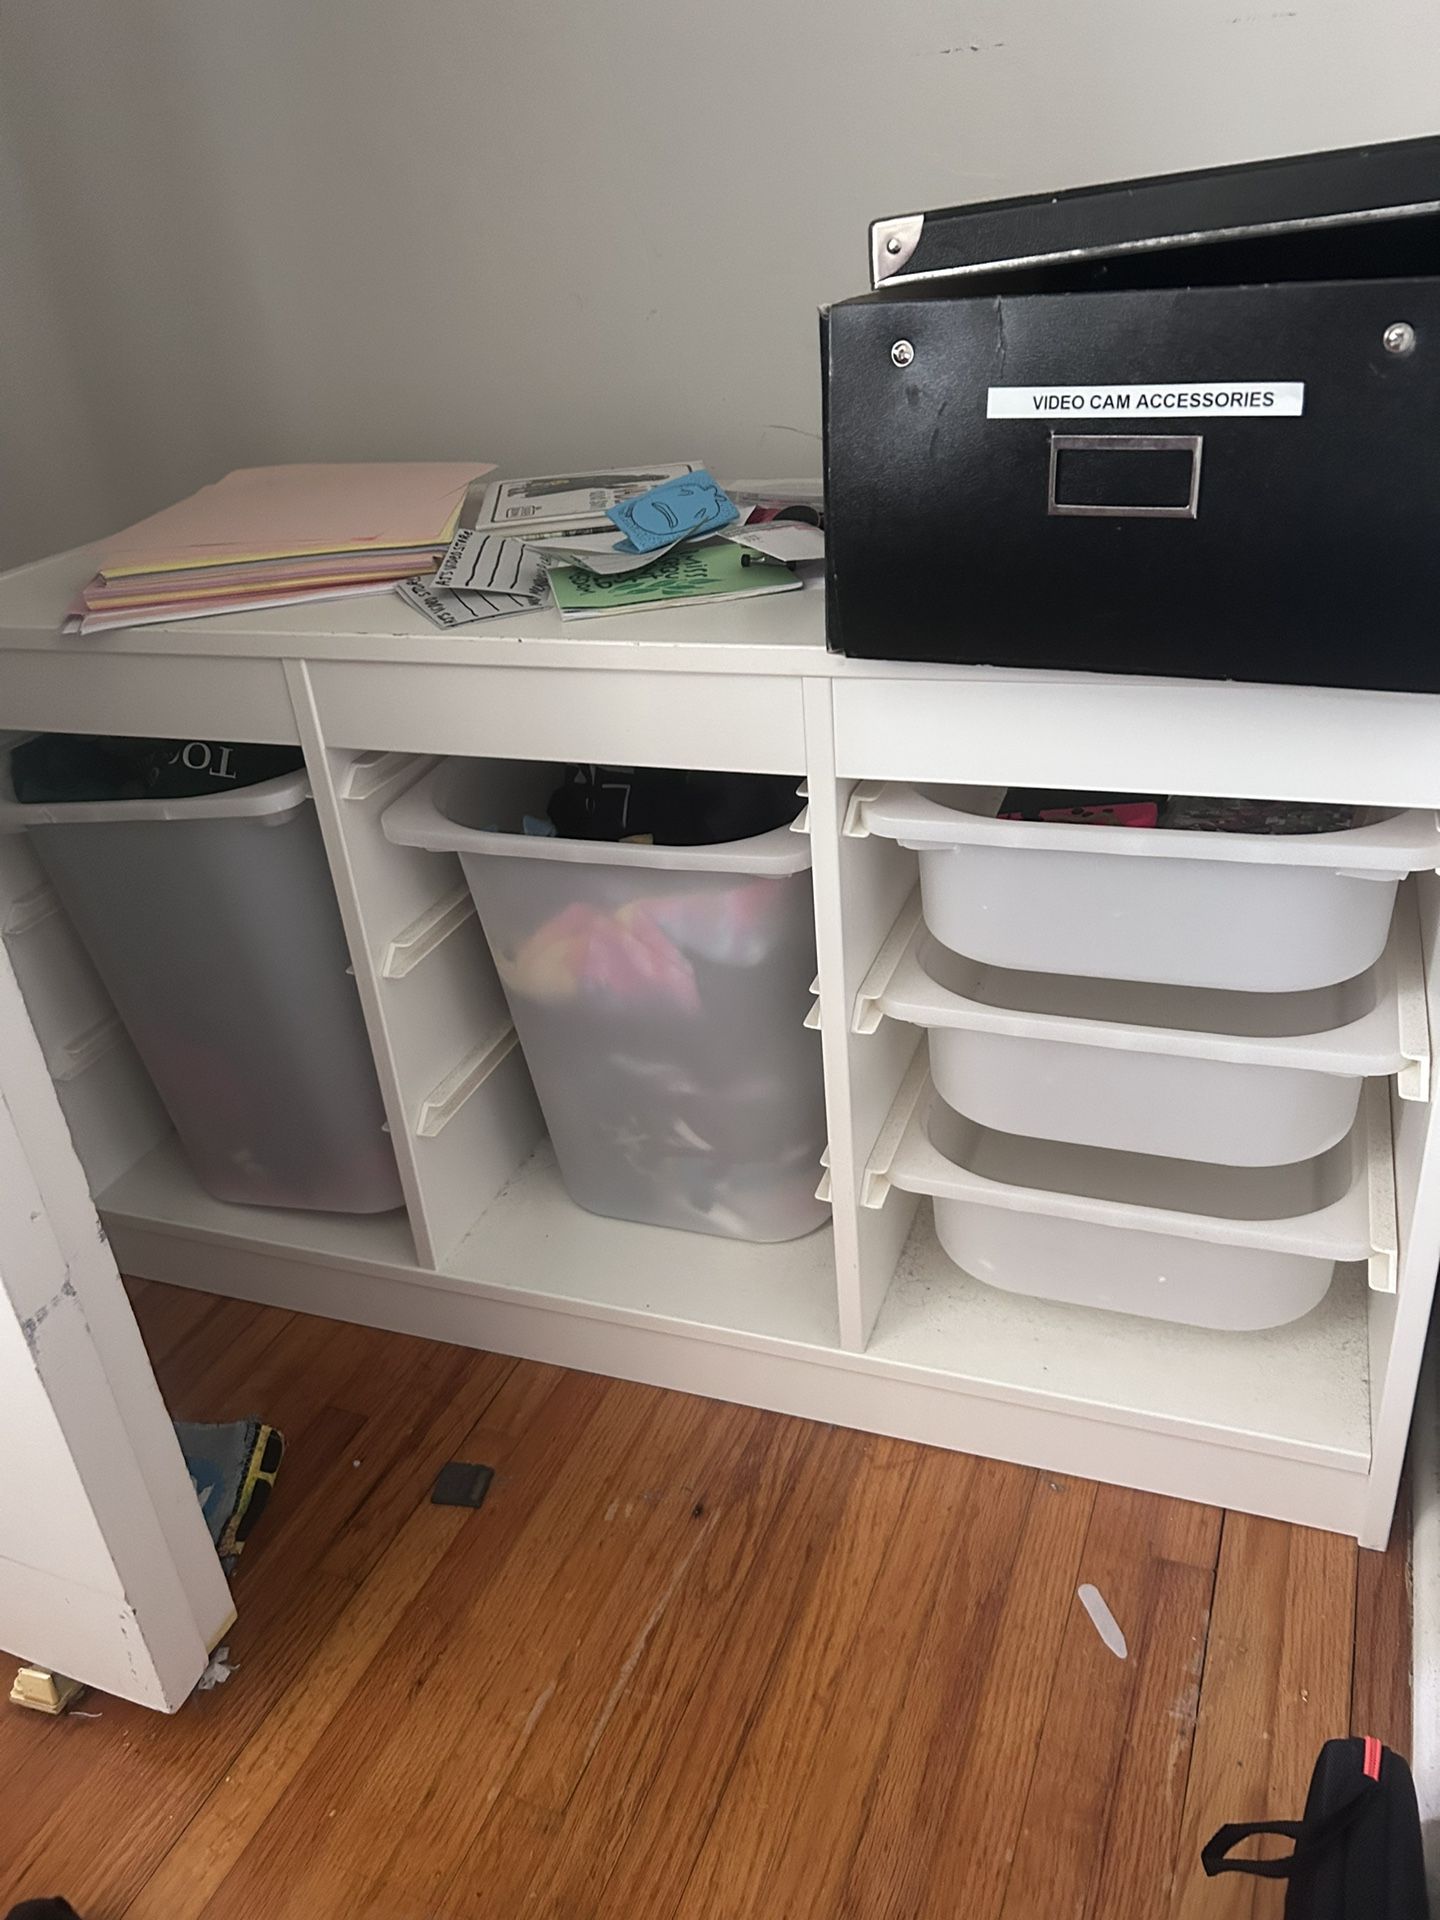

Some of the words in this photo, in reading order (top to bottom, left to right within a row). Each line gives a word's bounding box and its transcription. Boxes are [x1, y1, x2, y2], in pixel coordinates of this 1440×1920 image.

[1033, 395, 1084, 410] VIDEO
[1090, 394, 1130, 409] CAM
[1136, 392, 1274, 409] ACCESSORIES
